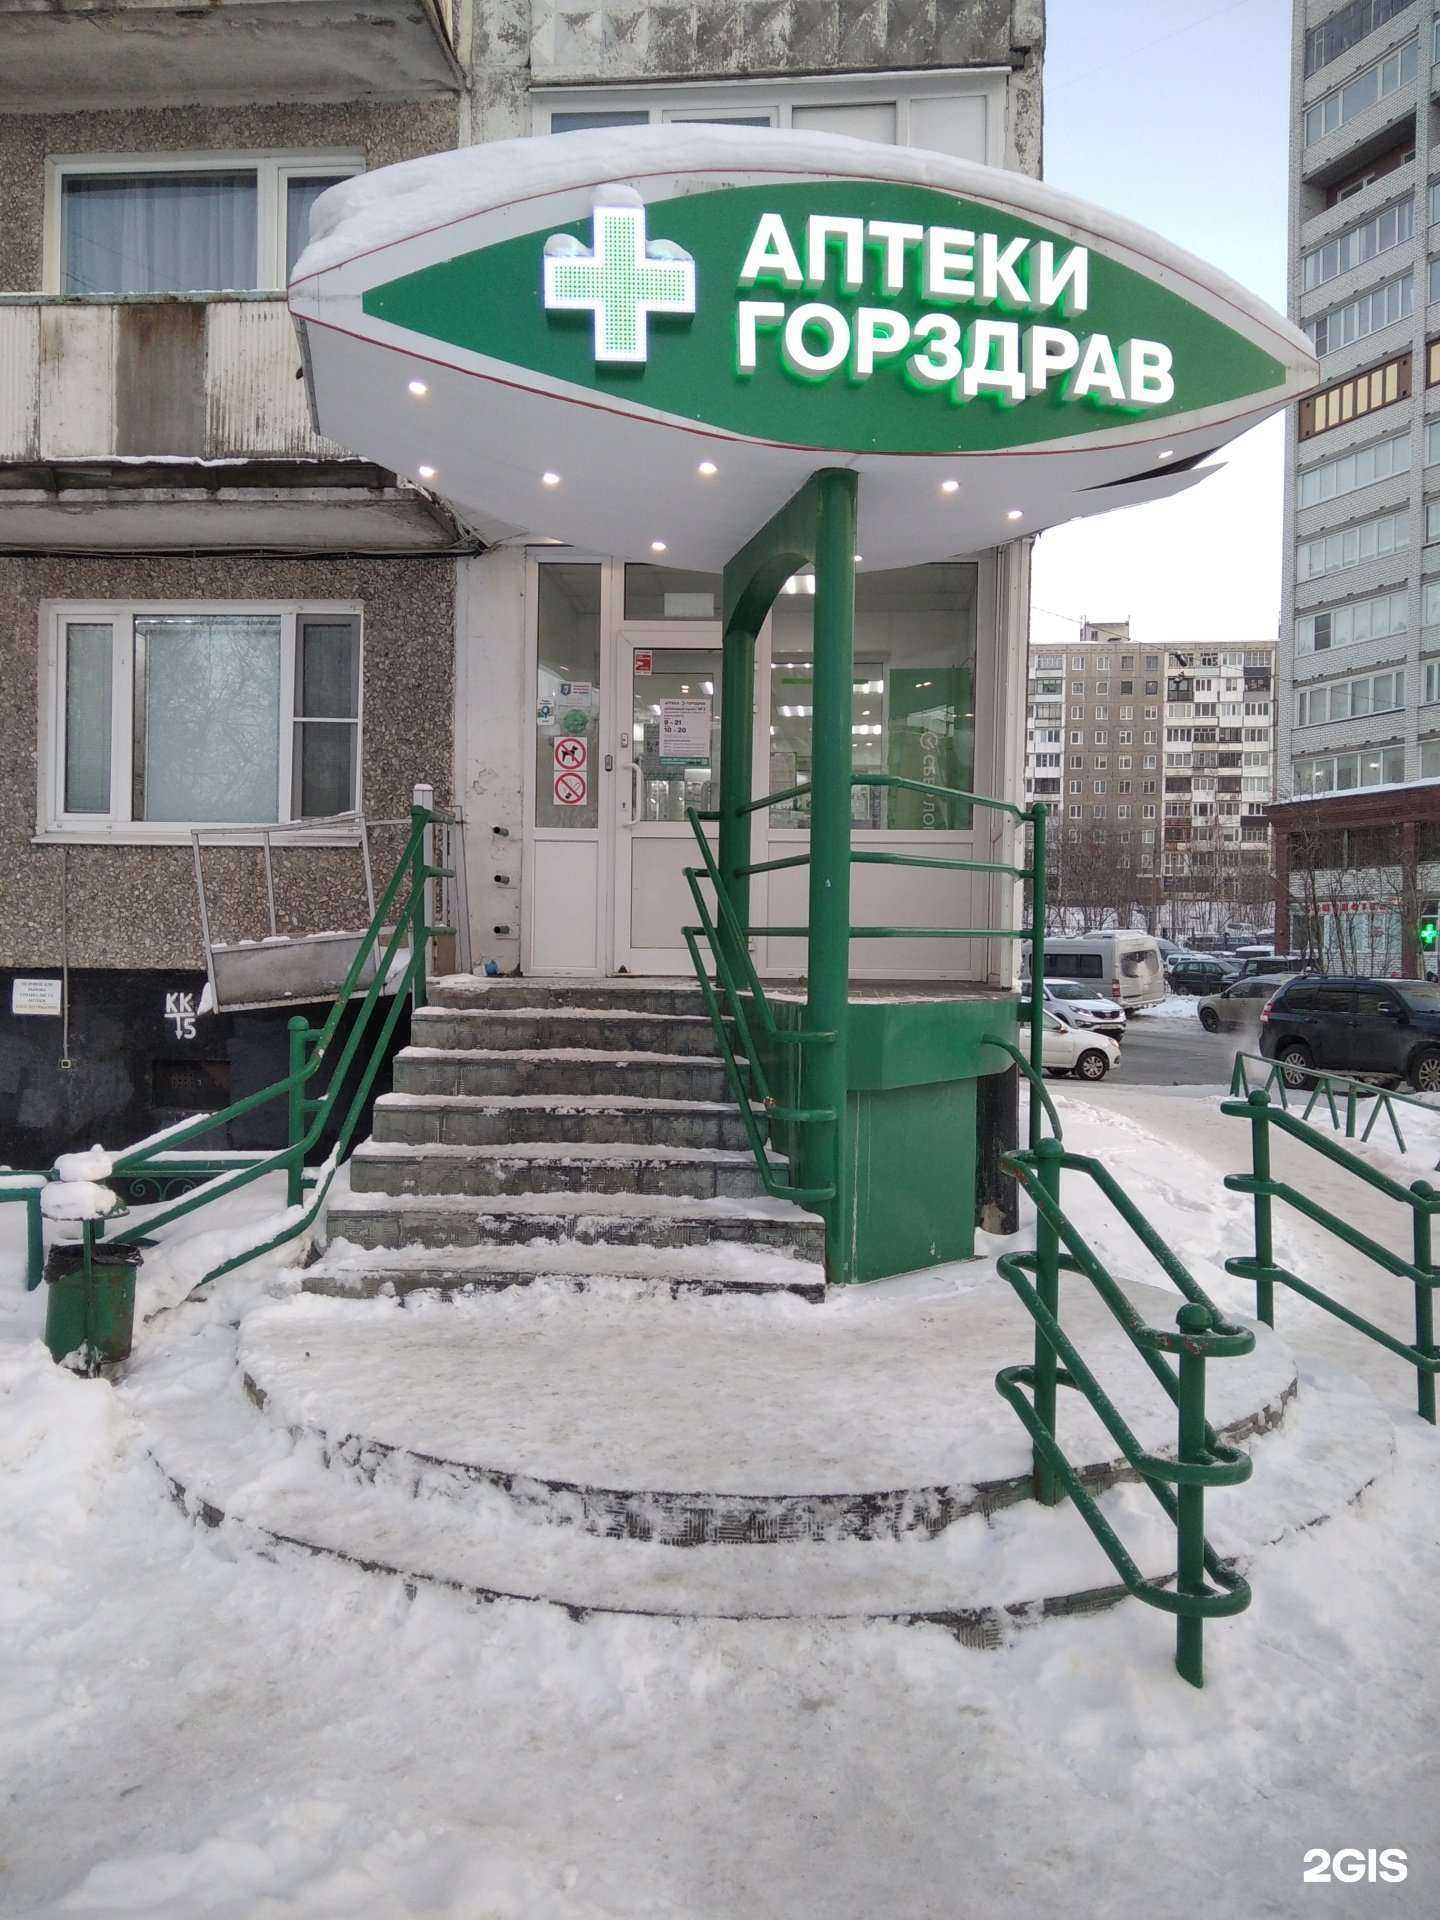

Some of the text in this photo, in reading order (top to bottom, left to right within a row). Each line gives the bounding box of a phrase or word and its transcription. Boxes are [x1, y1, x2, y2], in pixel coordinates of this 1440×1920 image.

[738, 212, 1089, 314] АПТЕКИ
[736, 300, 1176, 404] ГОРЗДРАВ
[183, 1017, 197, 1039] 5
